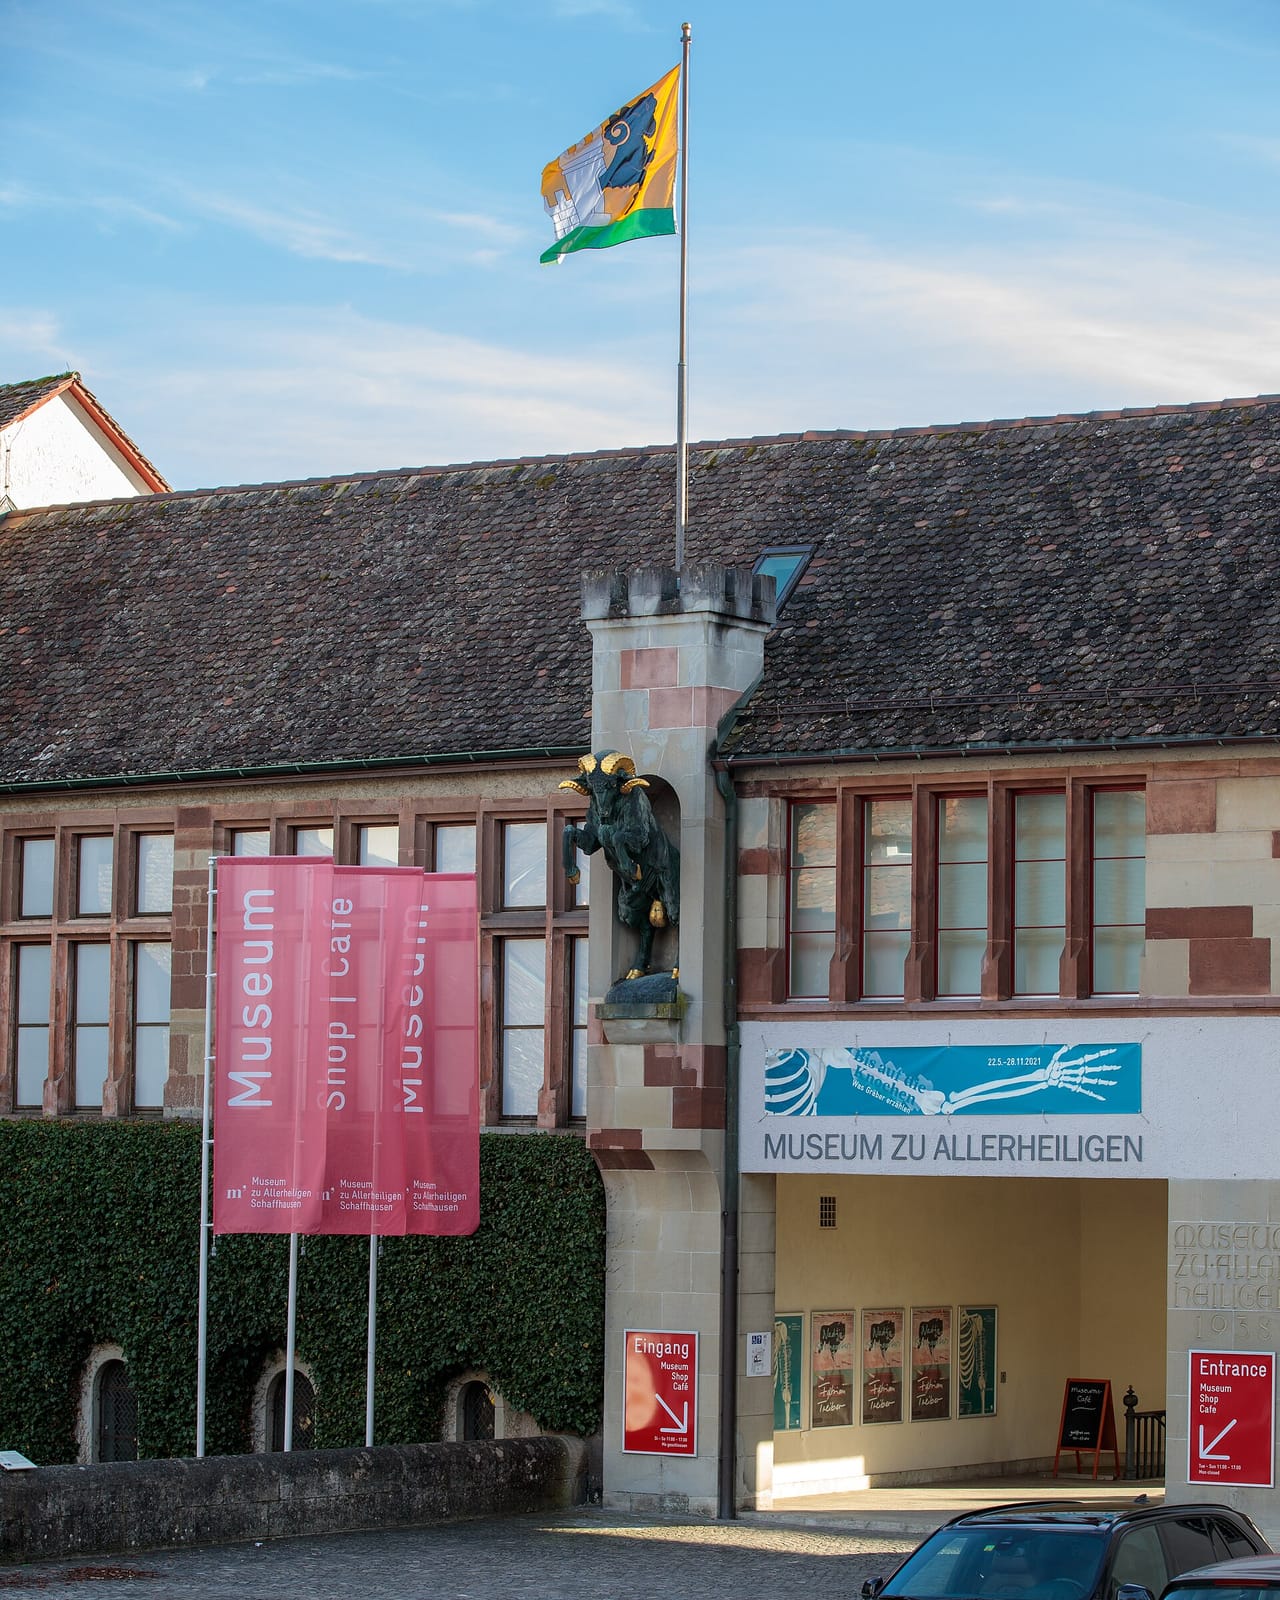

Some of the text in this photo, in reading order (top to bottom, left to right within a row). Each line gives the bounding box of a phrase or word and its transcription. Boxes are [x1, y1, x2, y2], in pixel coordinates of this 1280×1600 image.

[228, 889, 275, 1107] Museum
[852, 1078, 864, 1092] Was
[854, 1065, 916, 1105] Knochen
[764, 1133, 1143, 1162] MUSEUM ZU ALLERHEILIGEN
[251, 1176, 287, 1186] Museum
[340, 1179, 373, 1189] Museum
[251, 1189, 261, 1197] zu
[351, 1190, 402, 1203] Allerheiligen
[413, 1192, 422, 1200] zu
[250, 1198, 302, 1209] Schaffhausen
[340, 1201, 393, 1211] Schaffhausen
[1216, 1254, 1280, 1280] ALLE
[1174, 1281, 1280, 1309] HEILIGE
[634, 1337, 689, 1359] Eingang
[660, 1361, 689, 1371] Museum
[1200, 1358, 1267, 1377] Entrance
[671, 1372, 689, 1382] Shop
[672, 1382, 689, 1391] Café
[1200, 1383, 1232, 1393] Museum
[1199, 1394, 1219, 1405] Shop
